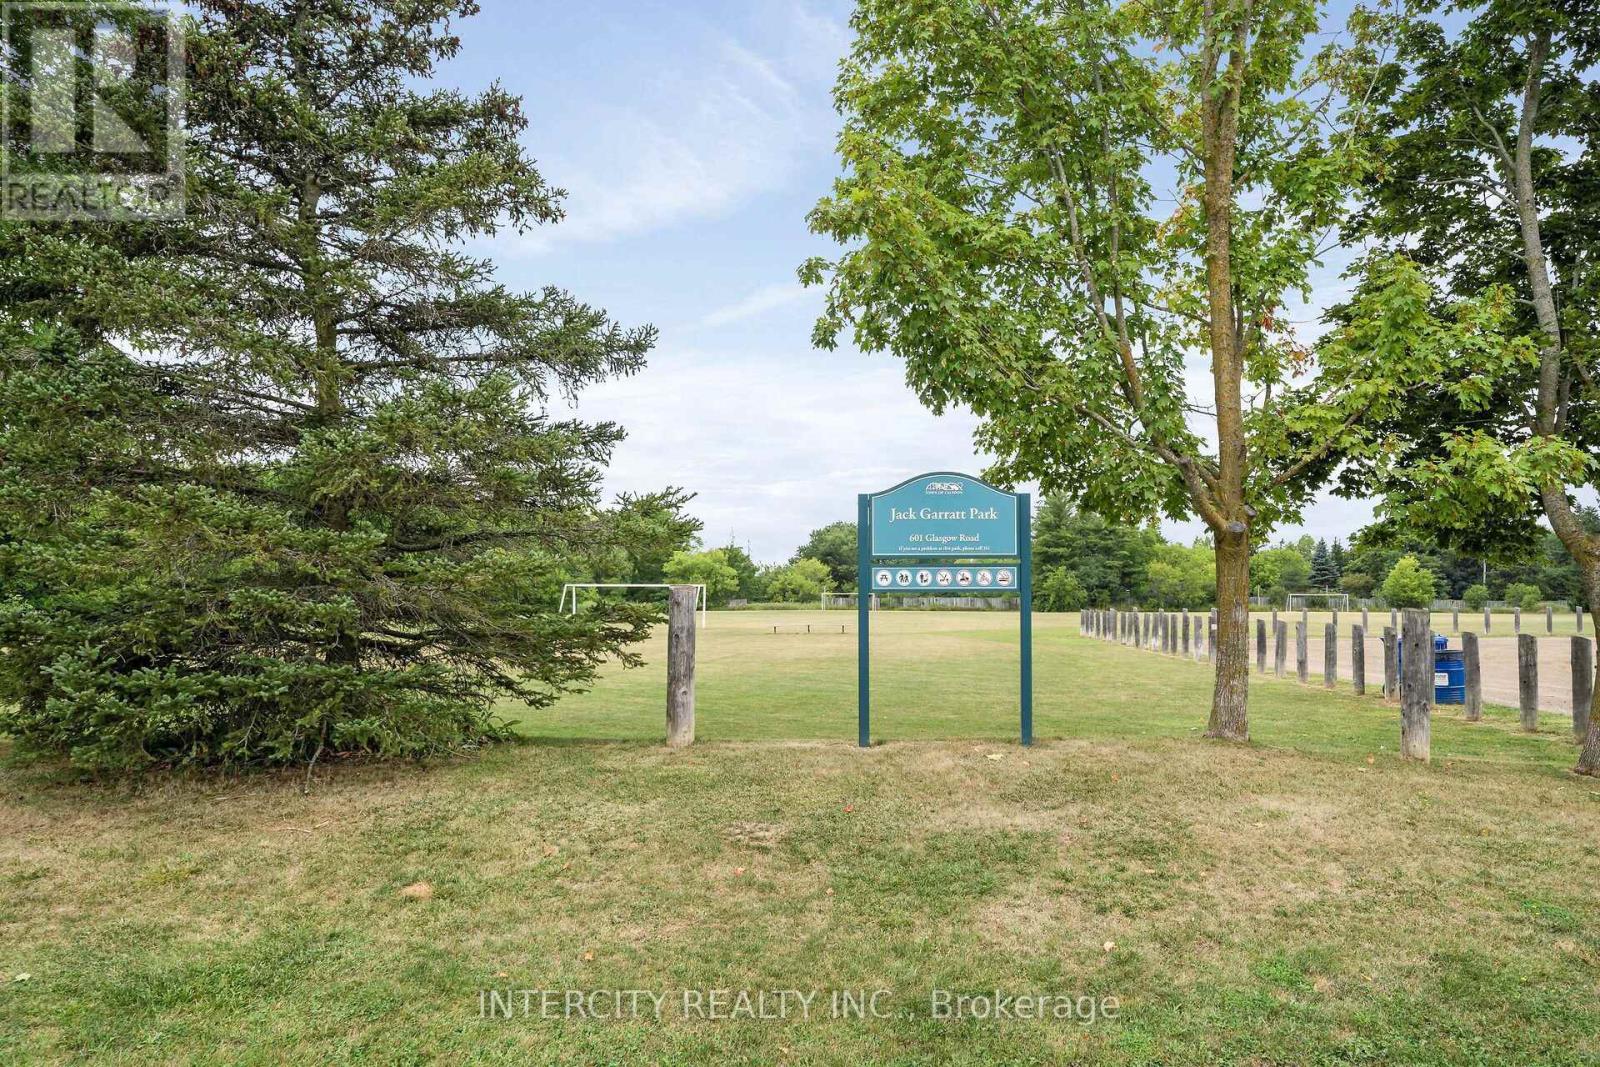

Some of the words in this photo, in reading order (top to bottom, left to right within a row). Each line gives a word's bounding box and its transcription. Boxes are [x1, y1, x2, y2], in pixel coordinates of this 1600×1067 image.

[889, 507, 917, 522] Jack
[920, 508, 965, 520] Garratt
[970, 507, 998, 520] Park
[909, 533, 923, 542] 601
[925, 533, 957, 544] Glasgow
[959, 533, 980, 542] Road
